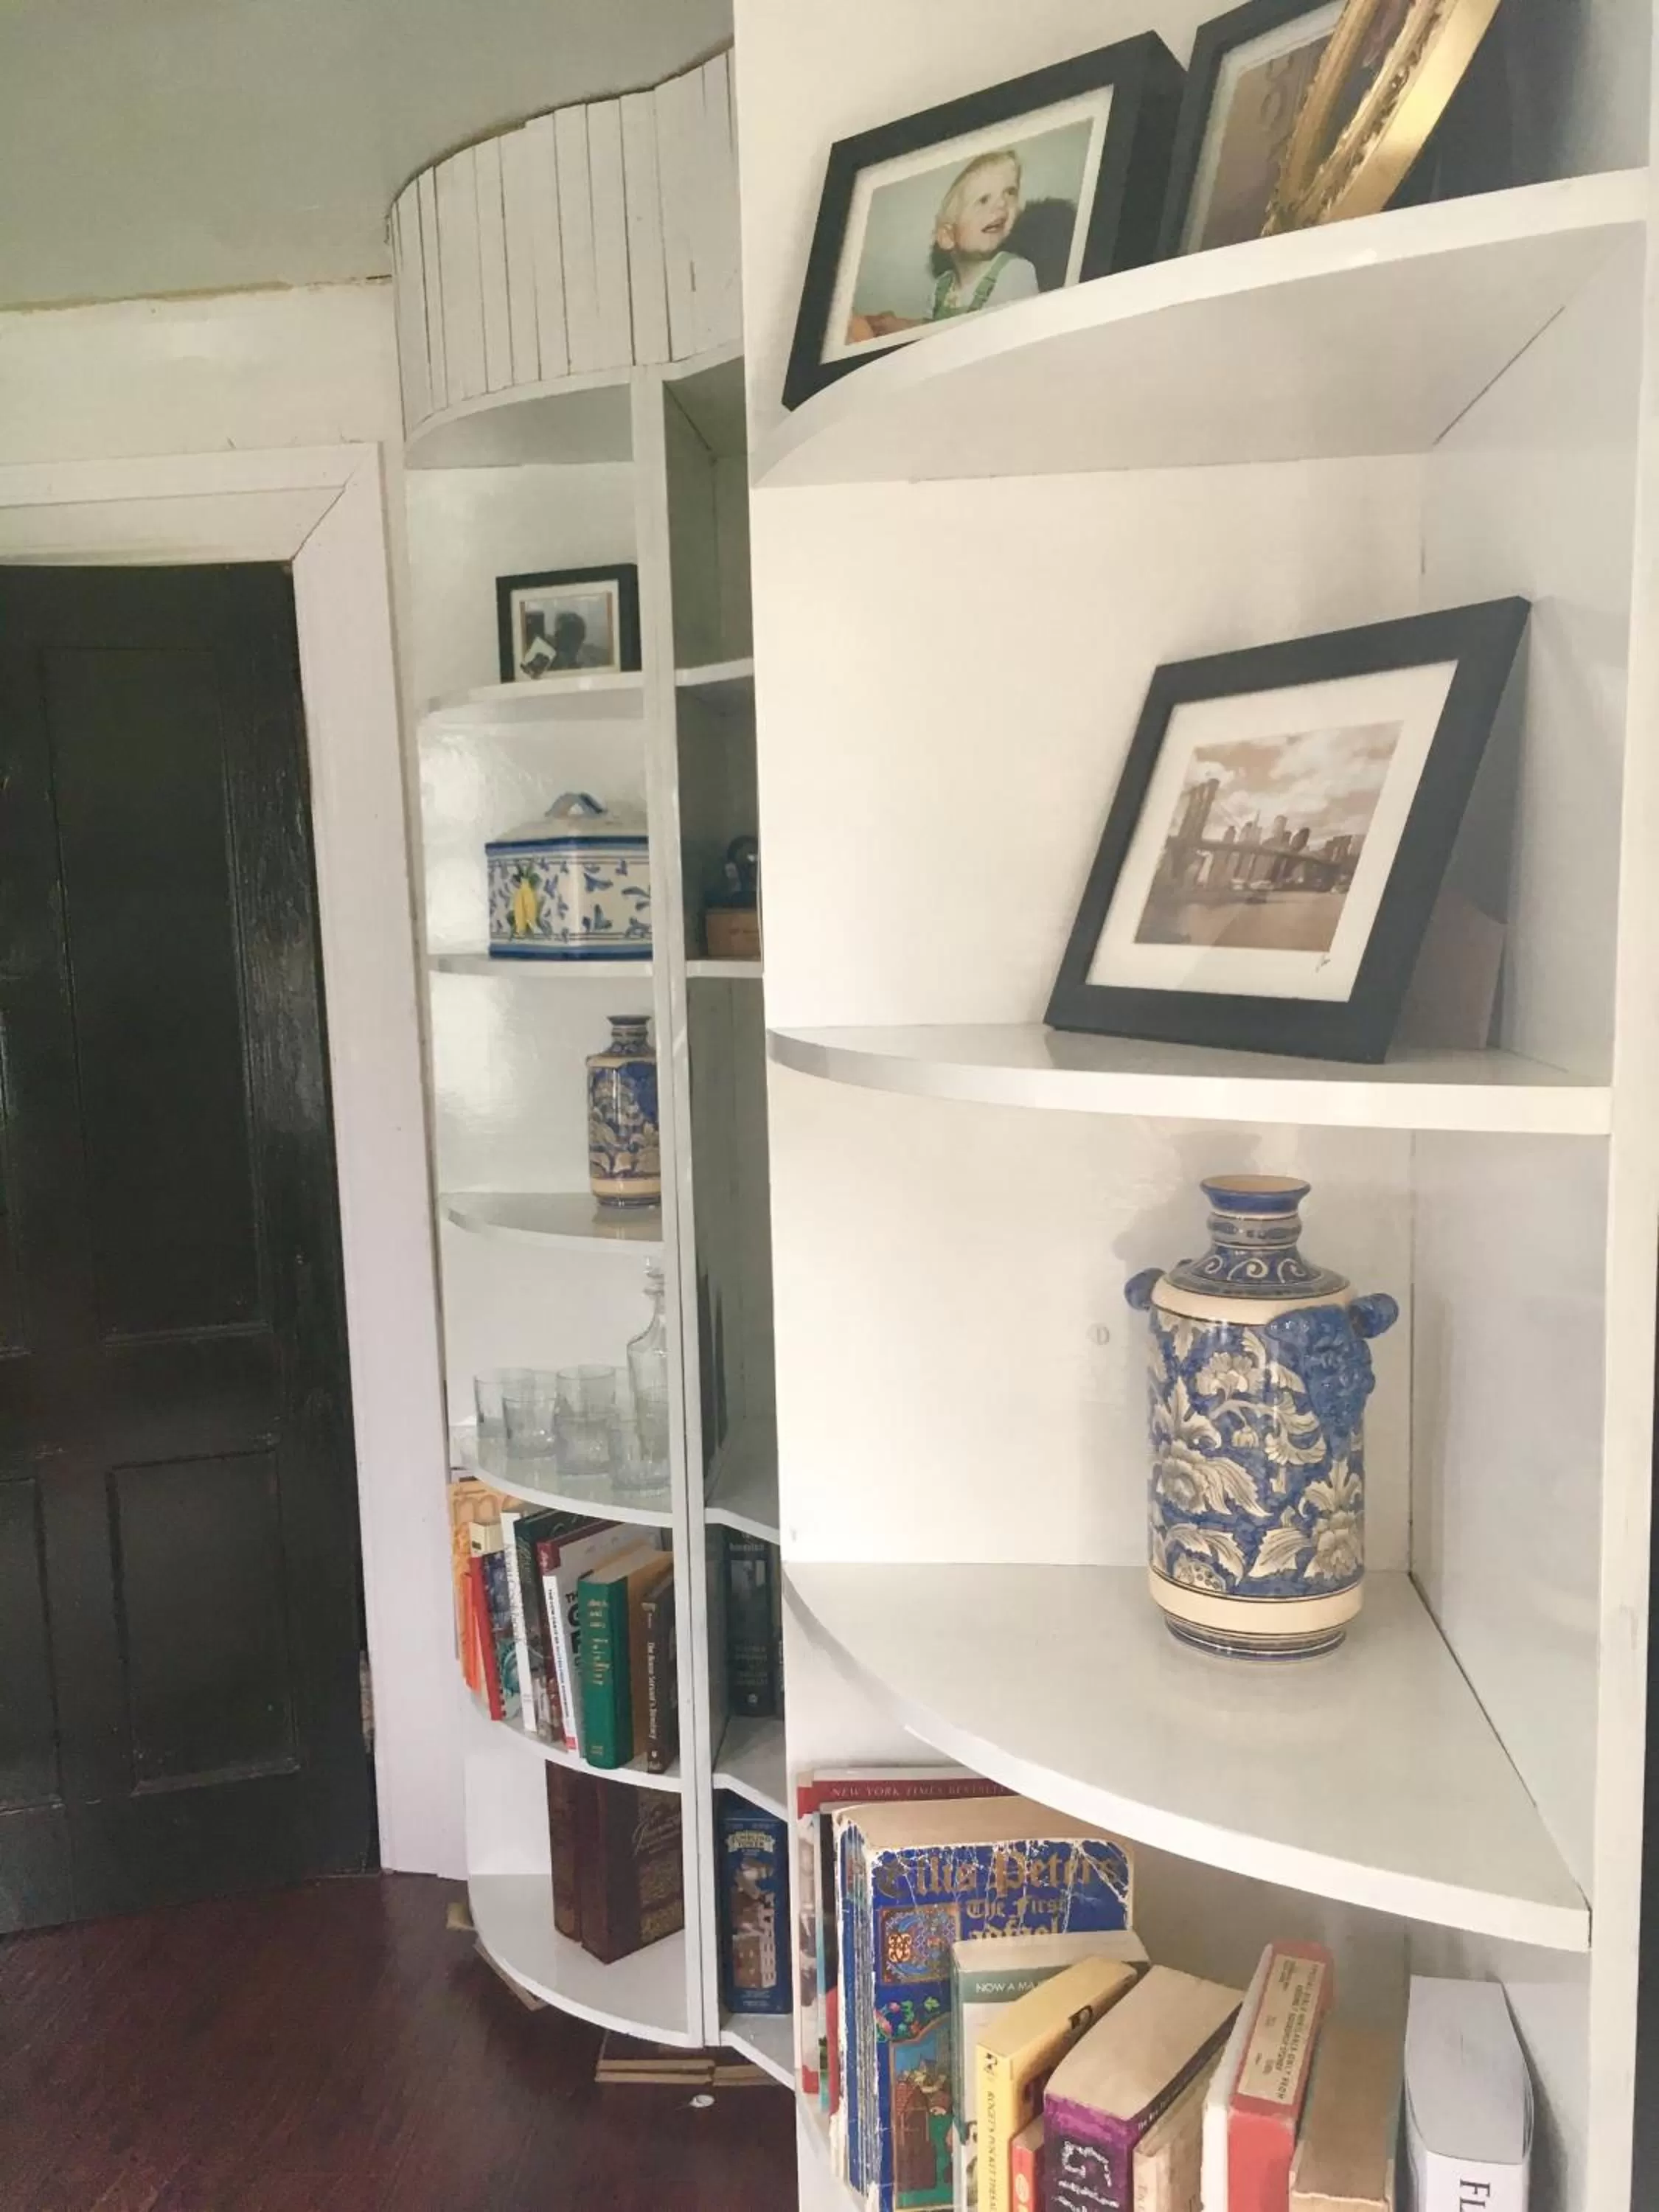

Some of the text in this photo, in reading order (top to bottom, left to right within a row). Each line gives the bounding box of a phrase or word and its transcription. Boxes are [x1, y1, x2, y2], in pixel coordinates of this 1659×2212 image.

[832, 1787, 859, 1798] NEW
[866, 1787, 900, 1797] YORK
[964, 1899, 1006, 1921] The
[975, 1981, 1007, 1994] NOW
[1007, 1983, 1015, 1993] A
